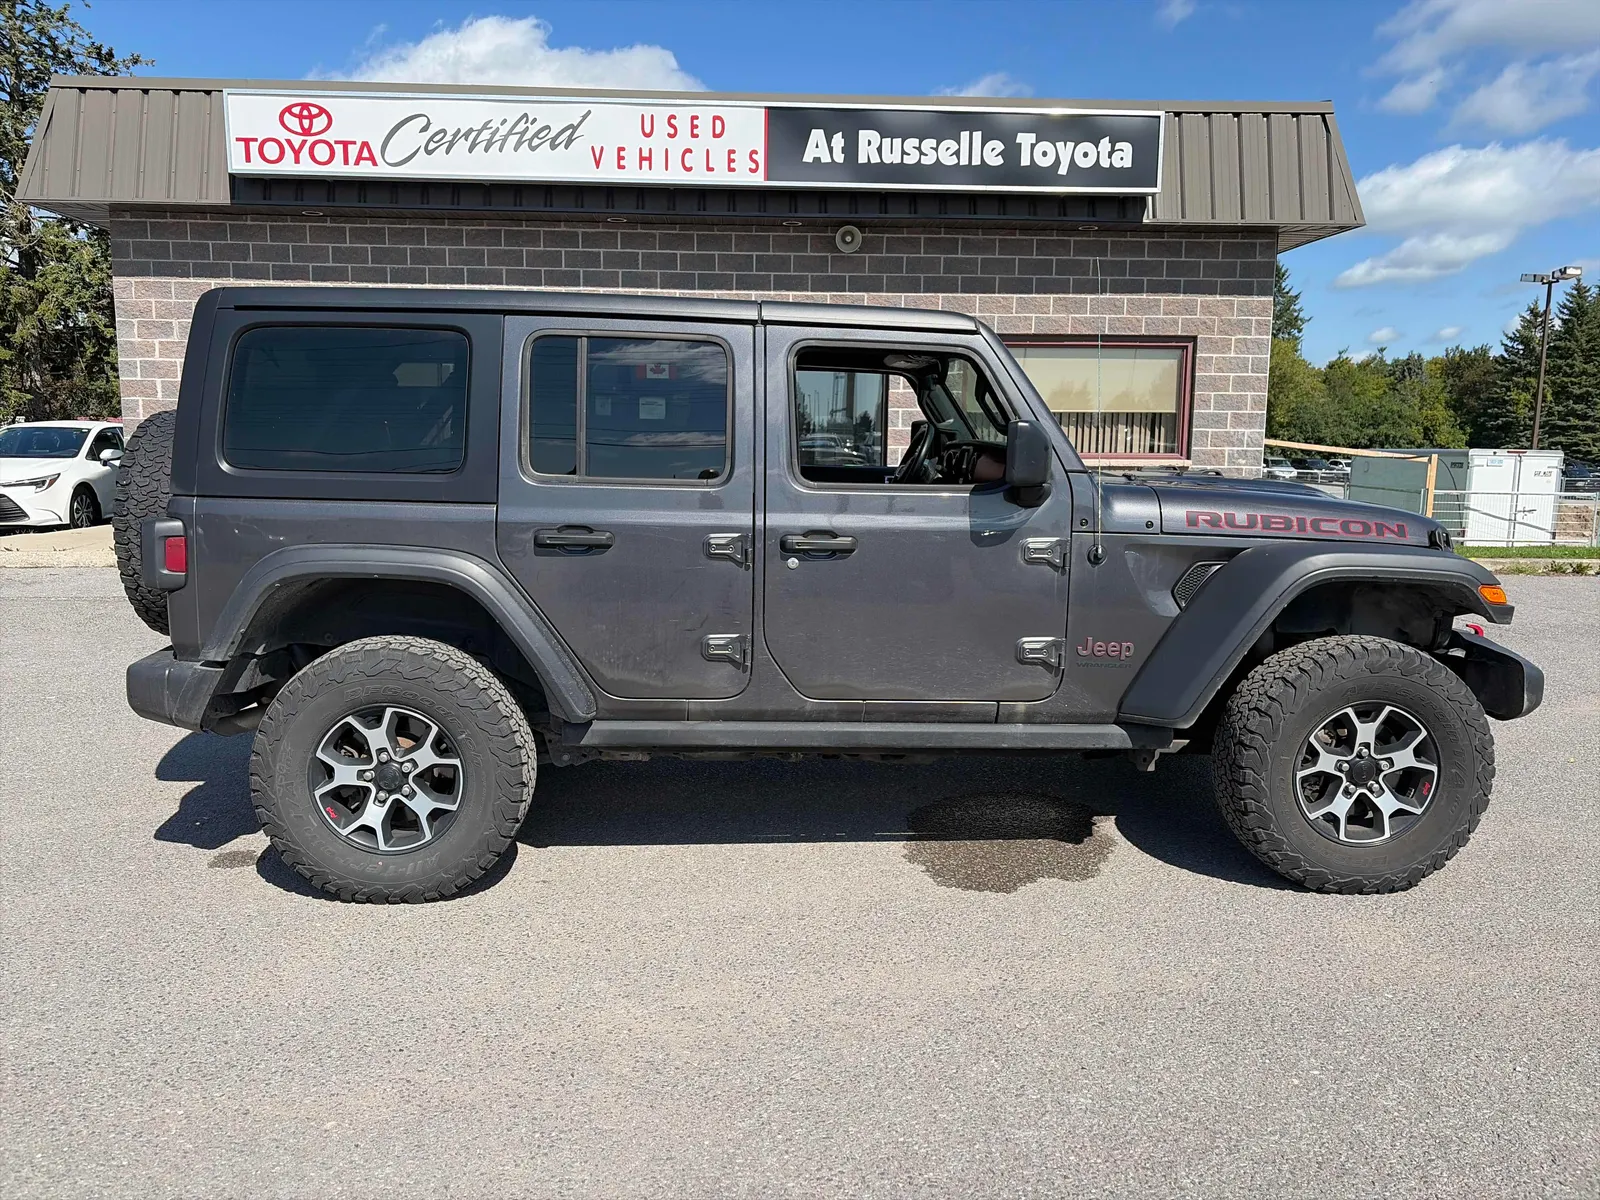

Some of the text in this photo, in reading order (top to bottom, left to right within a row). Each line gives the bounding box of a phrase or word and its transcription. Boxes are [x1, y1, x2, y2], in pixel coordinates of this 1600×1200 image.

[380, 109, 593, 168] Certified
[640, 113, 726, 139] USED
[235, 137, 378, 167] TOYOTA
[591, 145, 763, 174] VEHICLES
[802, 128, 1133, 176] At Russelle Toyota
[1186, 510, 1409, 540] RUBICON
[1076, 636, 1135, 662] Jeep
